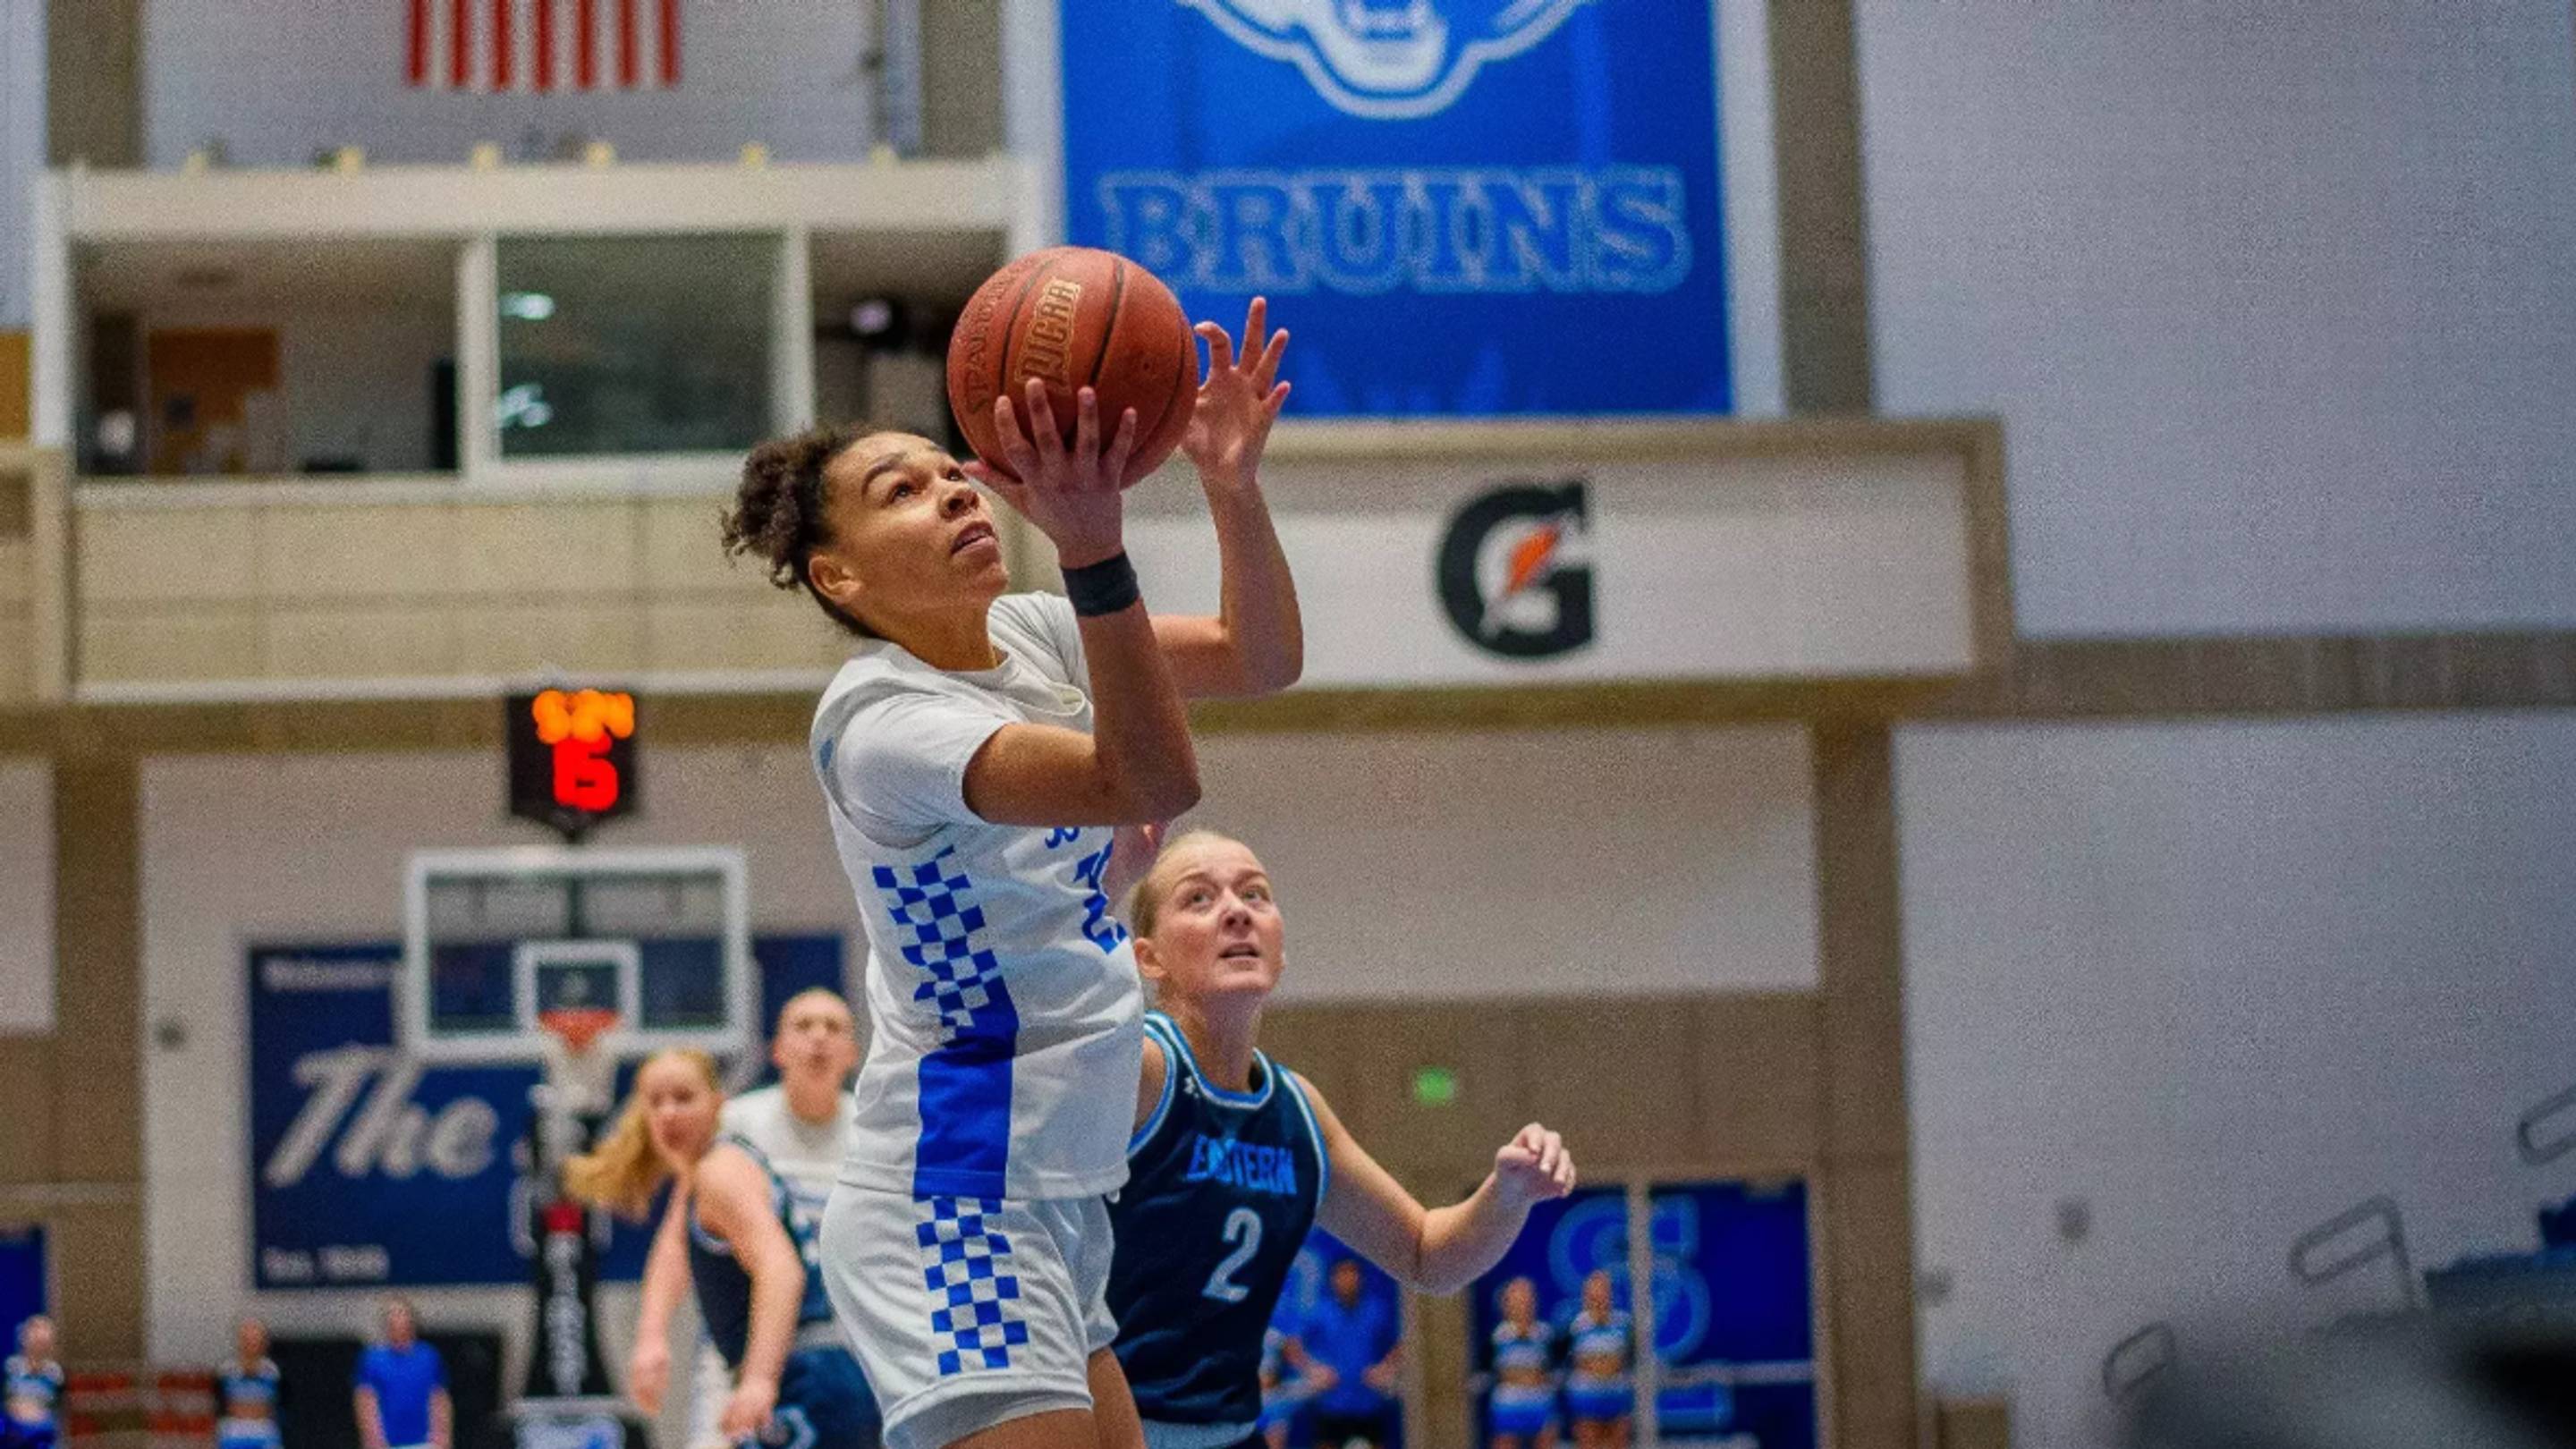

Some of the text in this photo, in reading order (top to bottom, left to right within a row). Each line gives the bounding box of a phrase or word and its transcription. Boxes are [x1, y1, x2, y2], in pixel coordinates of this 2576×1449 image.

[1097, 165, 1692, 295] BRUINS
[267, 1043, 499, 1188] The
[1201, 1207, 1262, 1302] 2
